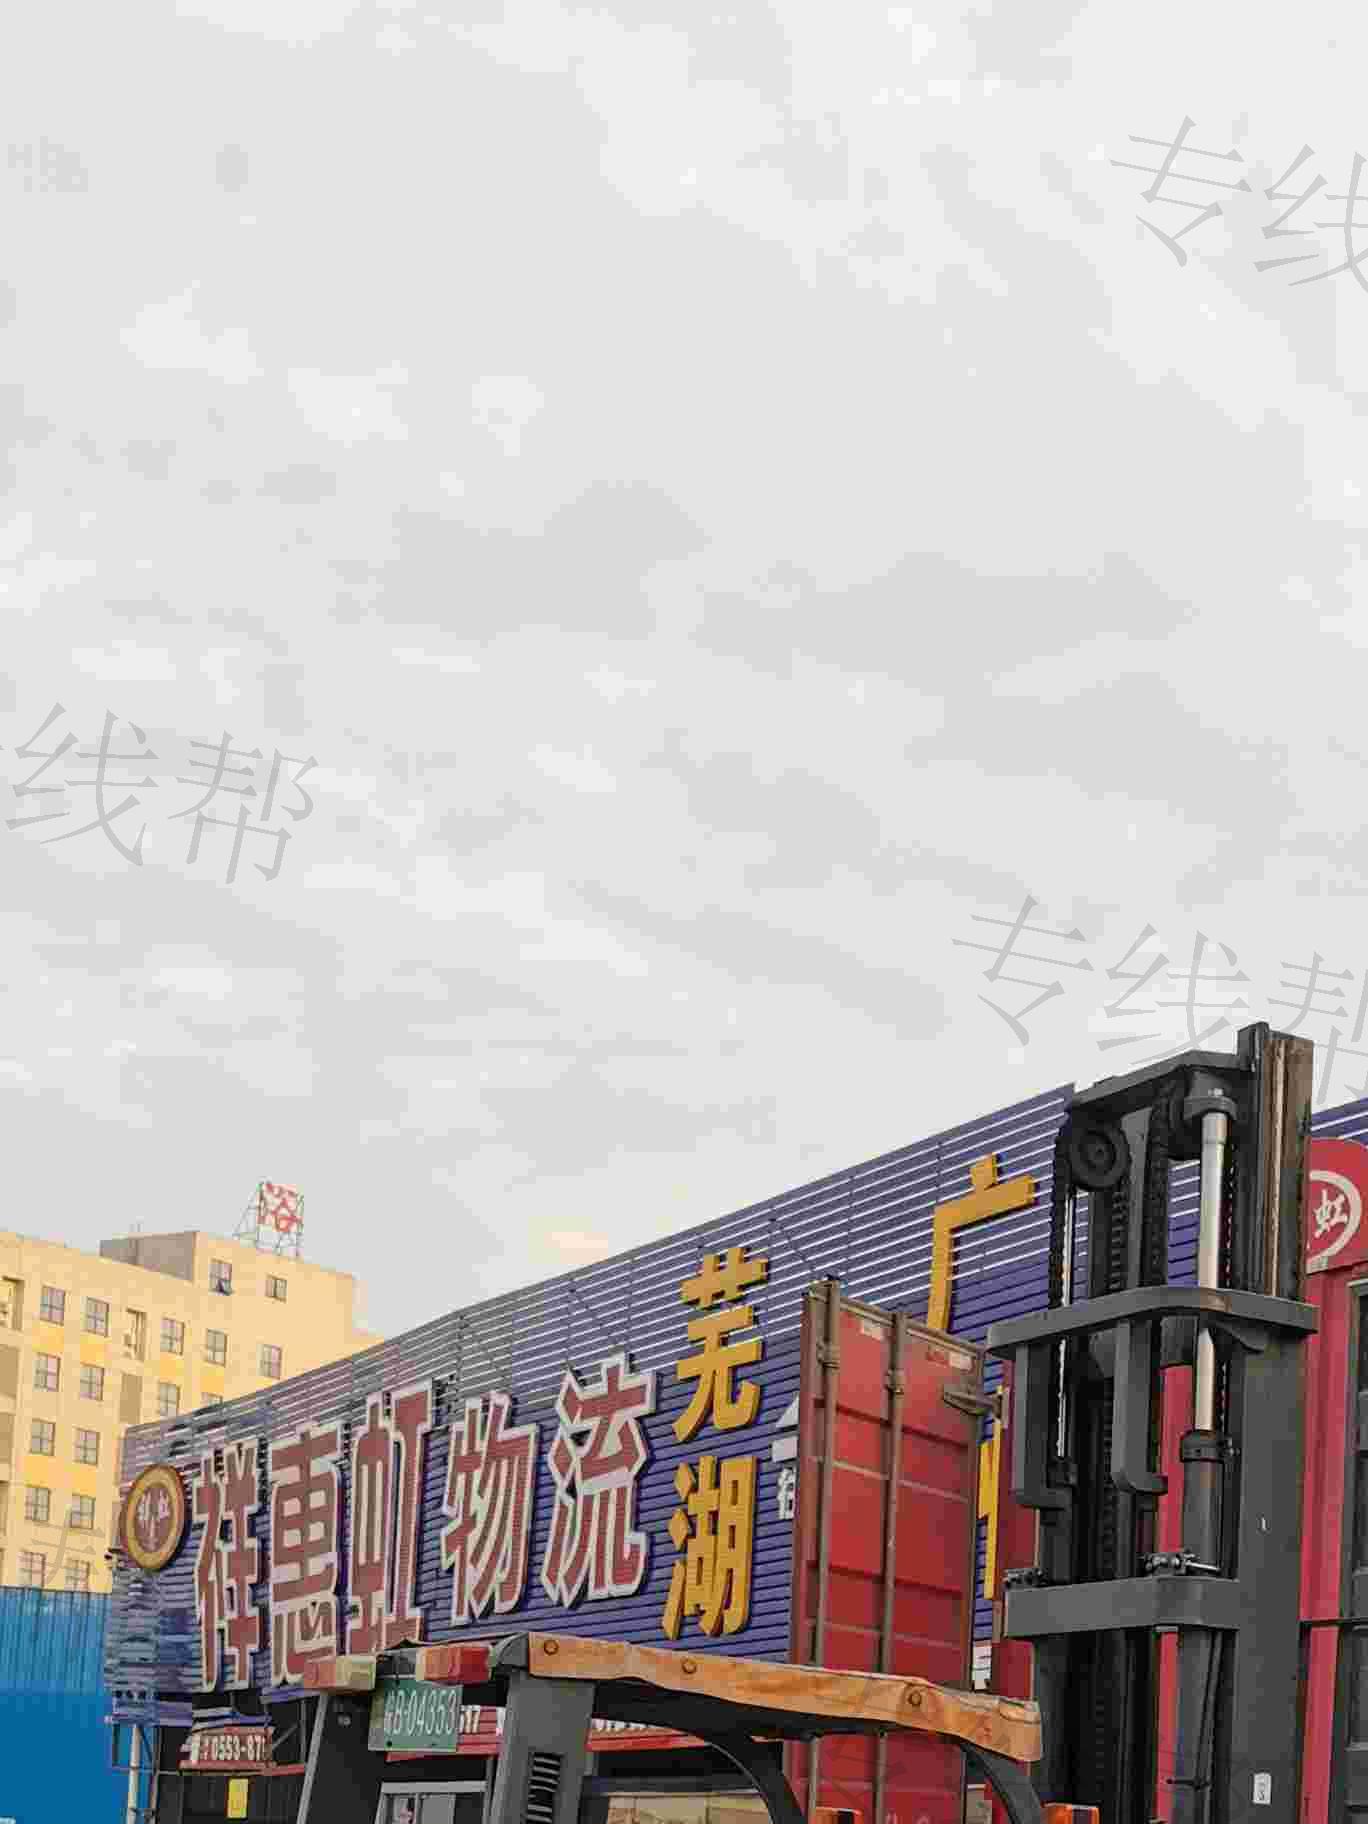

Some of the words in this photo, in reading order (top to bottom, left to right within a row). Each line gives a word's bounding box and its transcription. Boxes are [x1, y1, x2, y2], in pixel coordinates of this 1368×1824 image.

[193, 1352, 658, 1693] 祥惠虹物流
[661, 1247, 769, 1640] 芜湖
